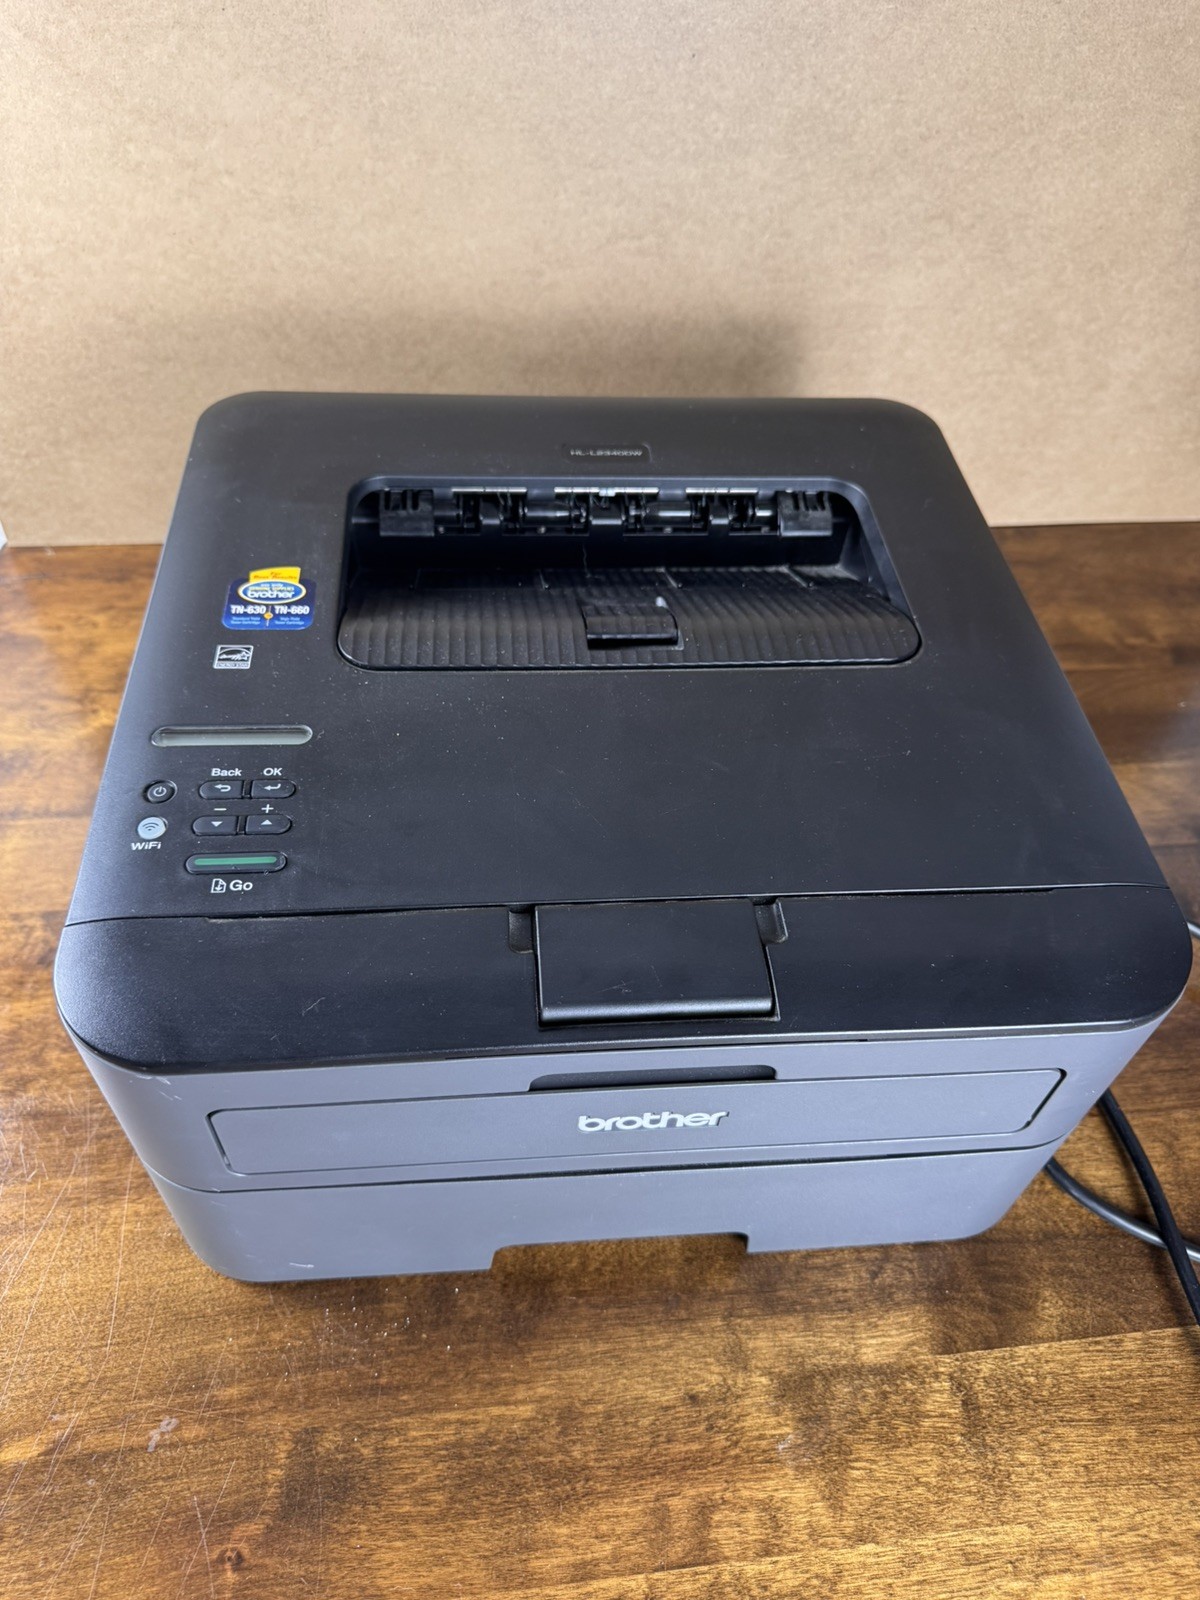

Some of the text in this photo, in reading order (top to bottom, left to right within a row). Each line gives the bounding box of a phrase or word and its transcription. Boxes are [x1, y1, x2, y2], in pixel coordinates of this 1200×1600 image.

[246, 589, 295, 599] brother
[230, 604, 310, 615] TN-630 TN-660
[211, 767, 242, 777] Back
[263, 767, 283, 776] OK
[131, 841, 162, 851] WiFi
[229, 879, 254, 891] Go
[578, 1110, 731, 1132] brother
